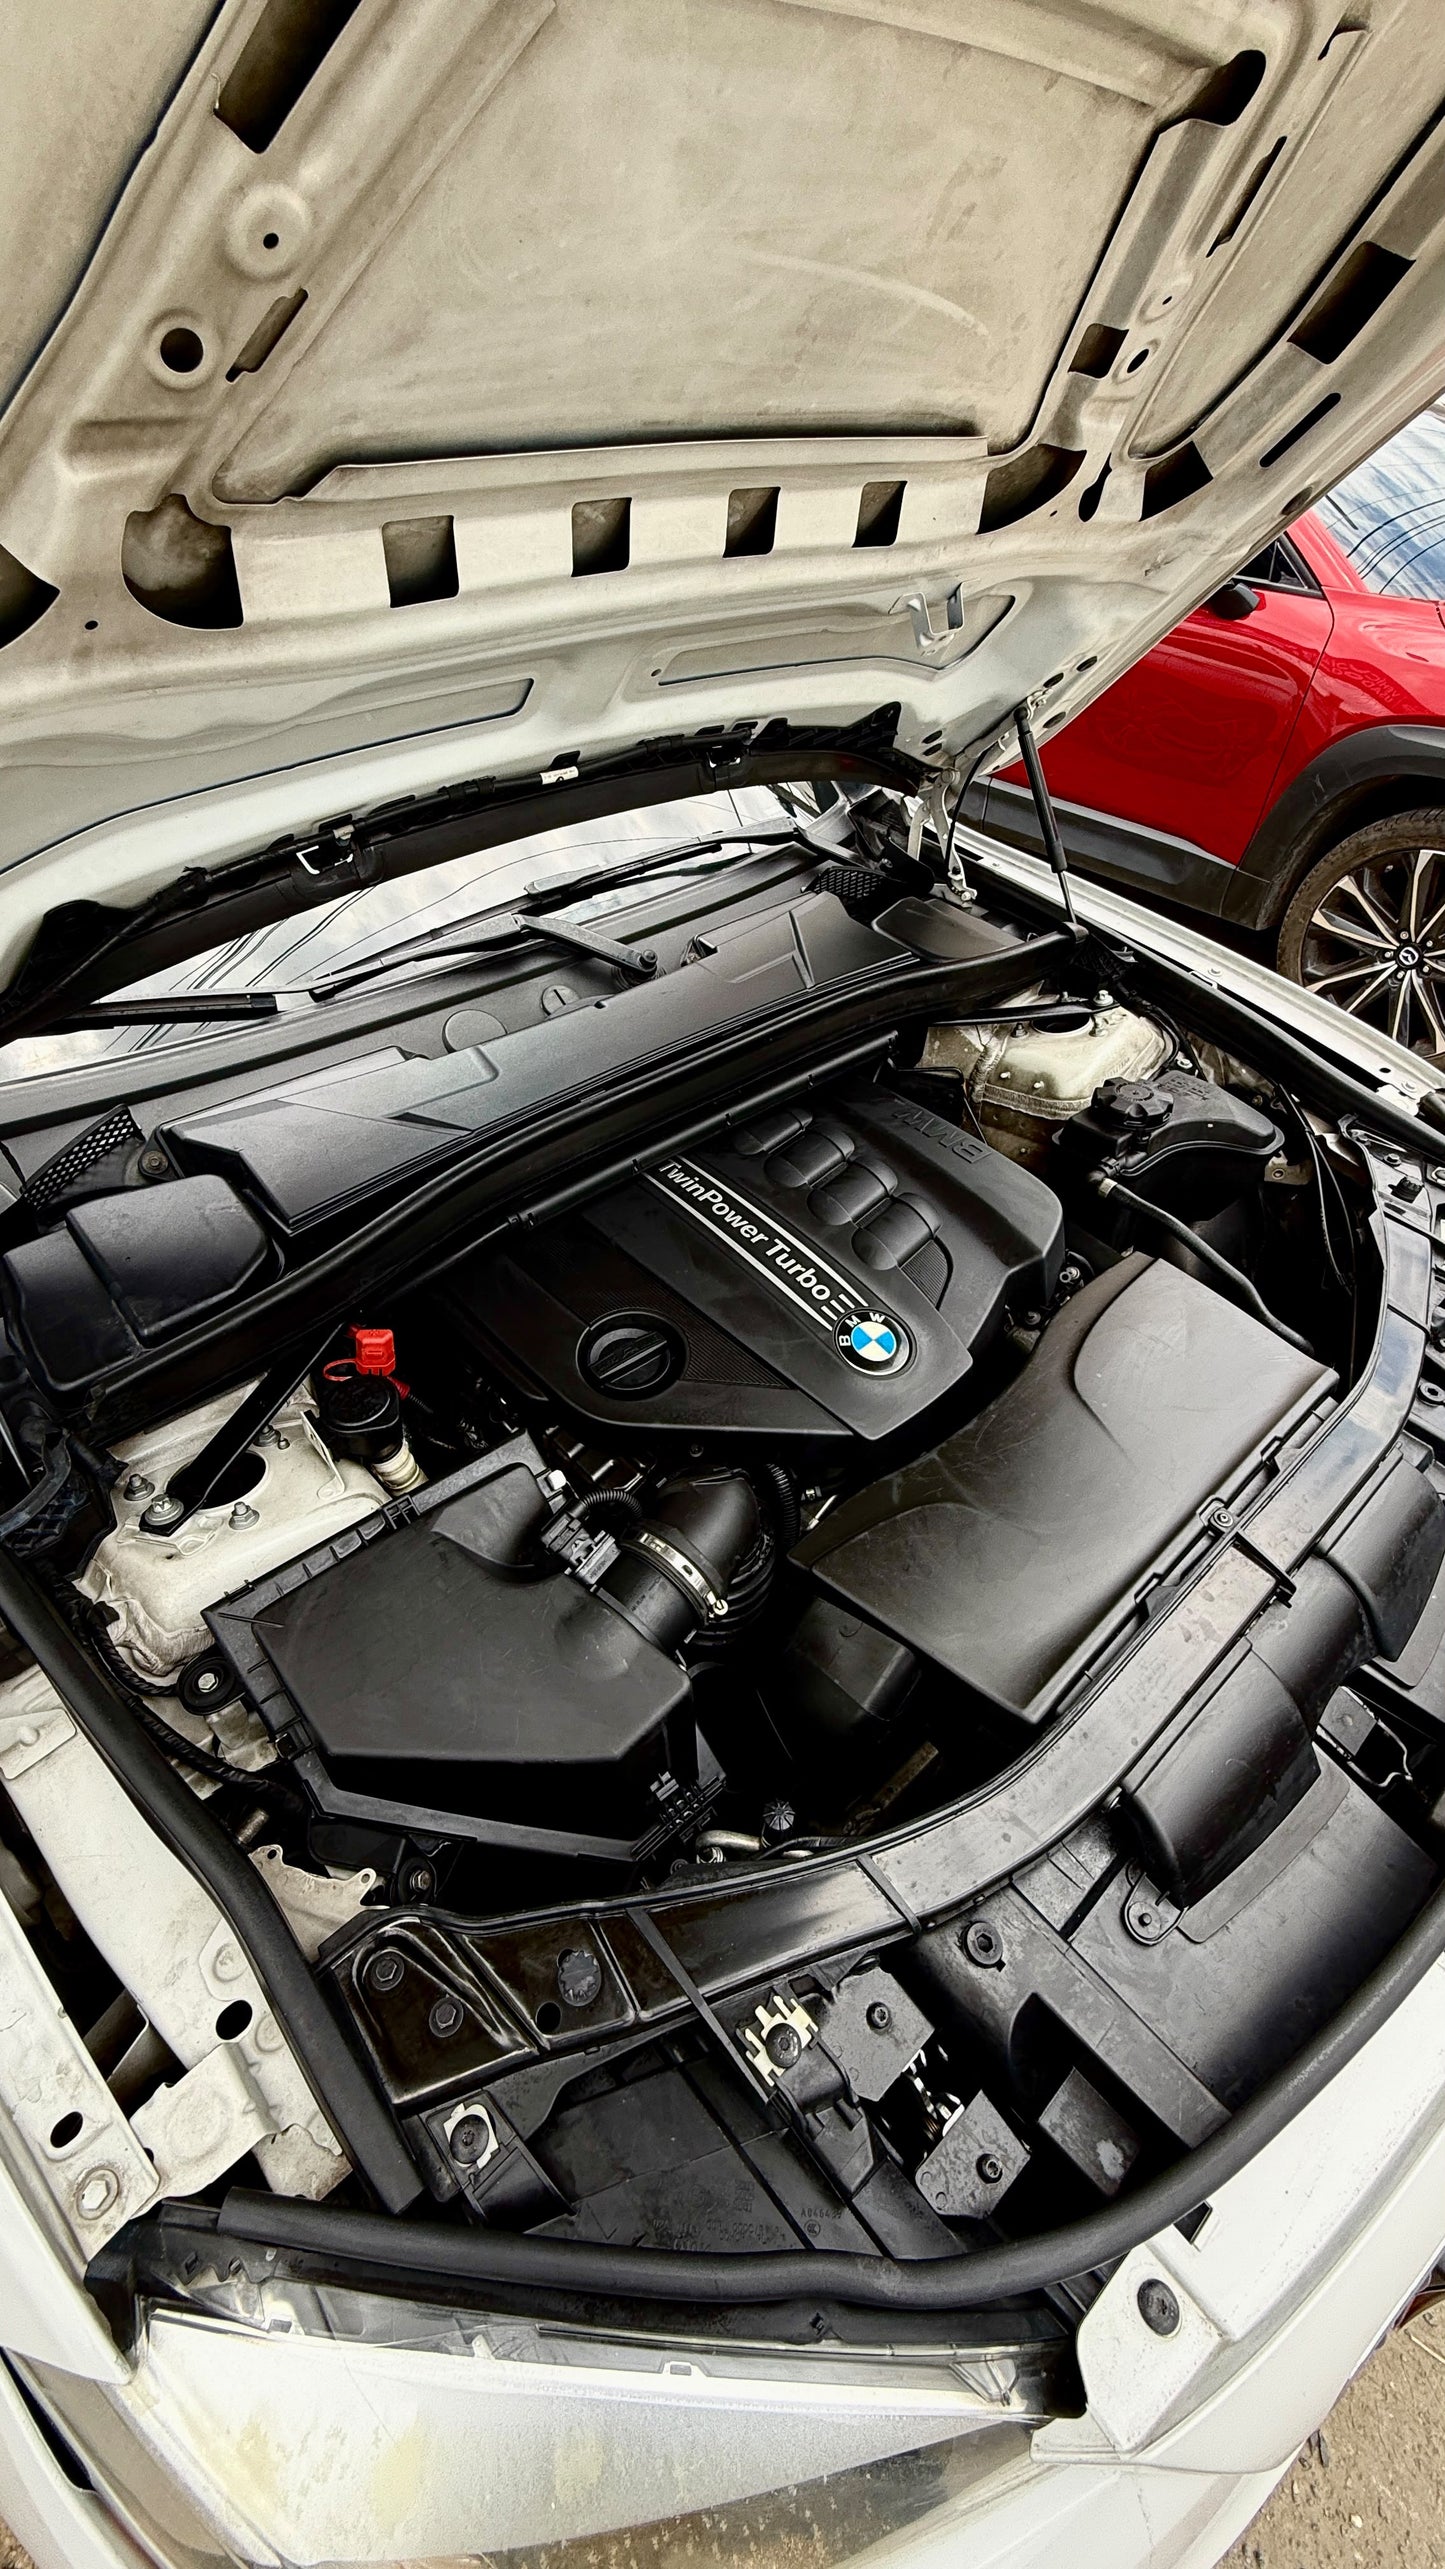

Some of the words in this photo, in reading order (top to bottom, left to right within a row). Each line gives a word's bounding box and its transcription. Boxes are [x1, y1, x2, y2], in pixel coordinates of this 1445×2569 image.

[892, 1110, 992, 1164] BMW
[658, 1159, 769, 1244] TwinPower
[765, 1238, 831, 1301] Turbo
[839, 1312, 886, 1346] BMW
